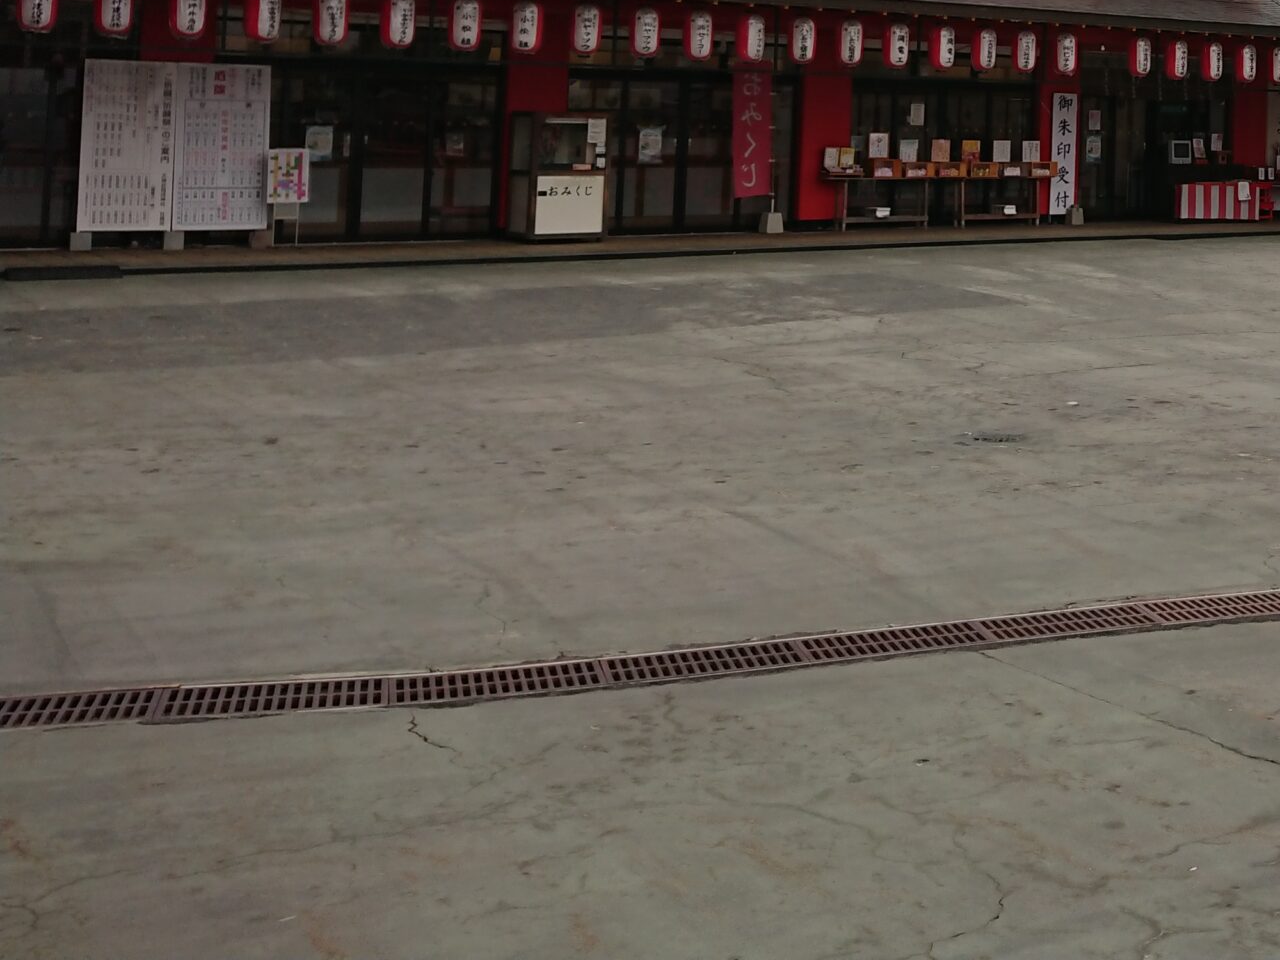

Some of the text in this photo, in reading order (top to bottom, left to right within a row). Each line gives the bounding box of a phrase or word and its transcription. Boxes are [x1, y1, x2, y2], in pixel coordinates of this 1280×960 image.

[1054, 95, 1074, 209] 御朱印受付
[548, 185, 593, 197] おみくじ
